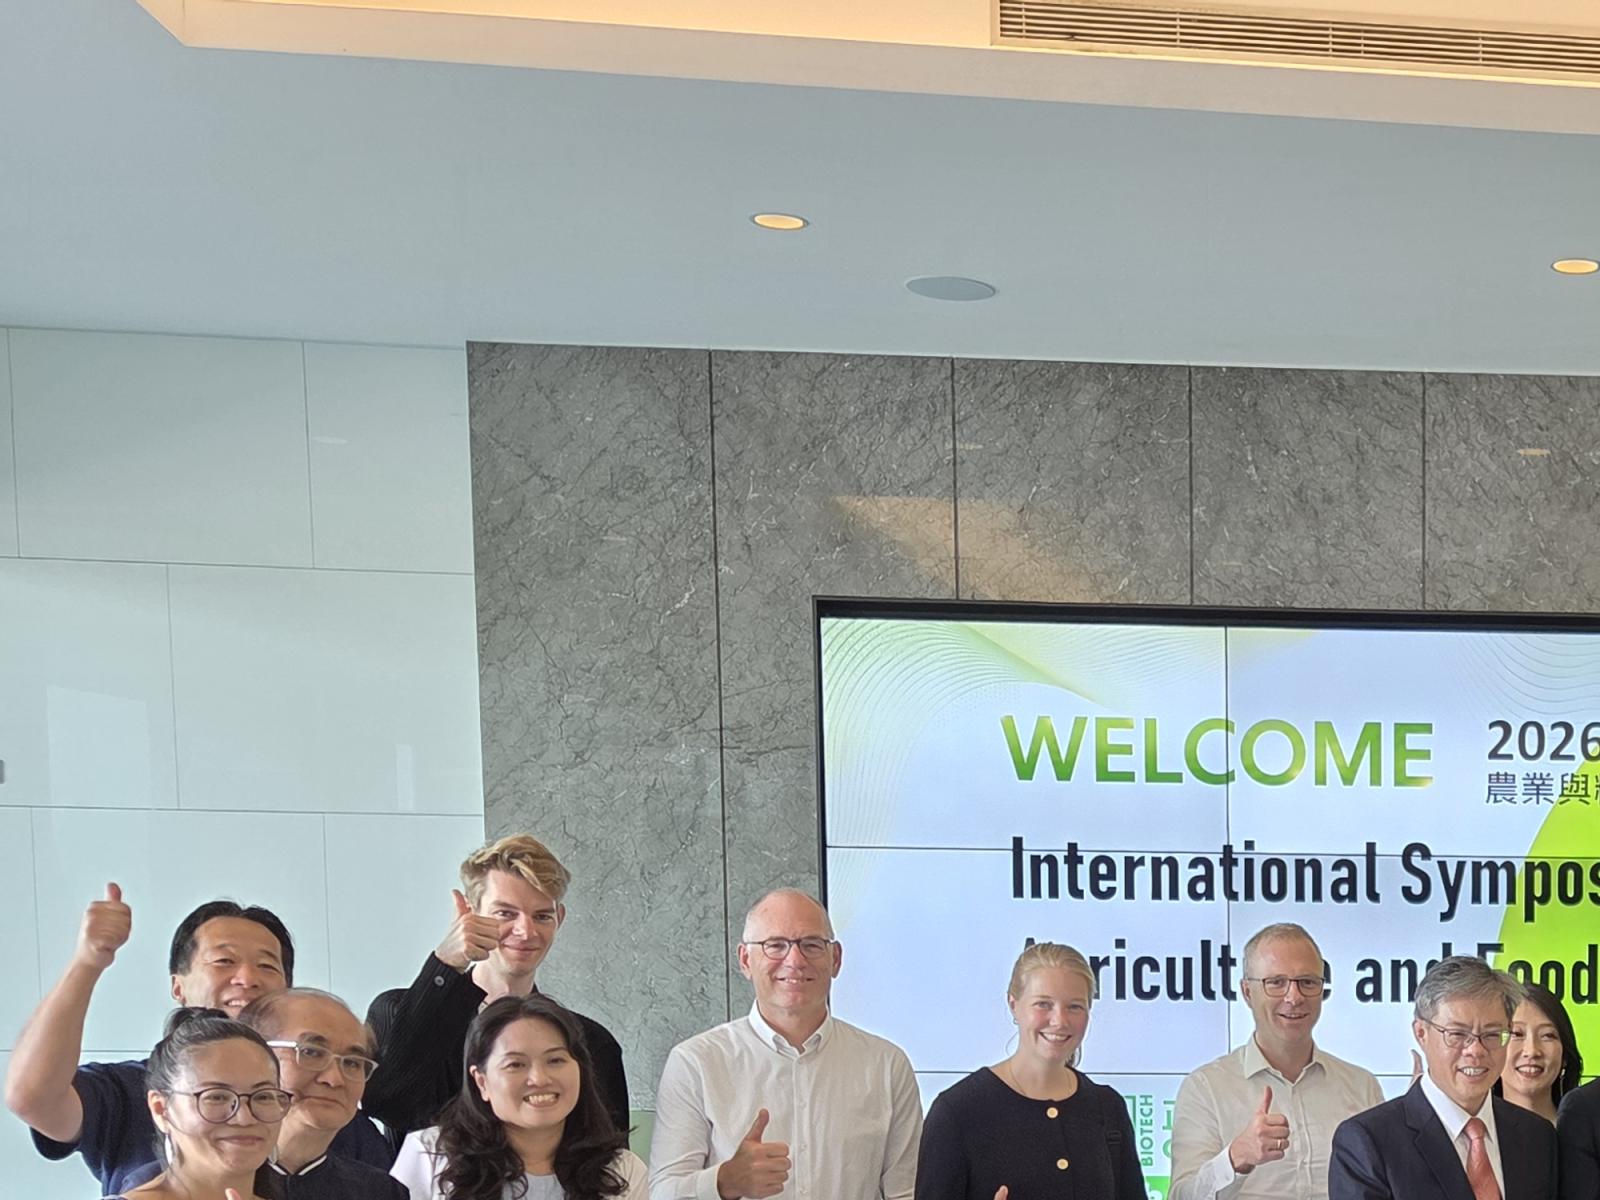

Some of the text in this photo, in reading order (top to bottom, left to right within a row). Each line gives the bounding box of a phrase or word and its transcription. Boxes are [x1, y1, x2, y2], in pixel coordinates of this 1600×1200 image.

[1000, 715, 1434, 787] WELCOME
[1012, 836, 1381, 904] International
[1140, 1095, 1154, 1167] BIOTECH
